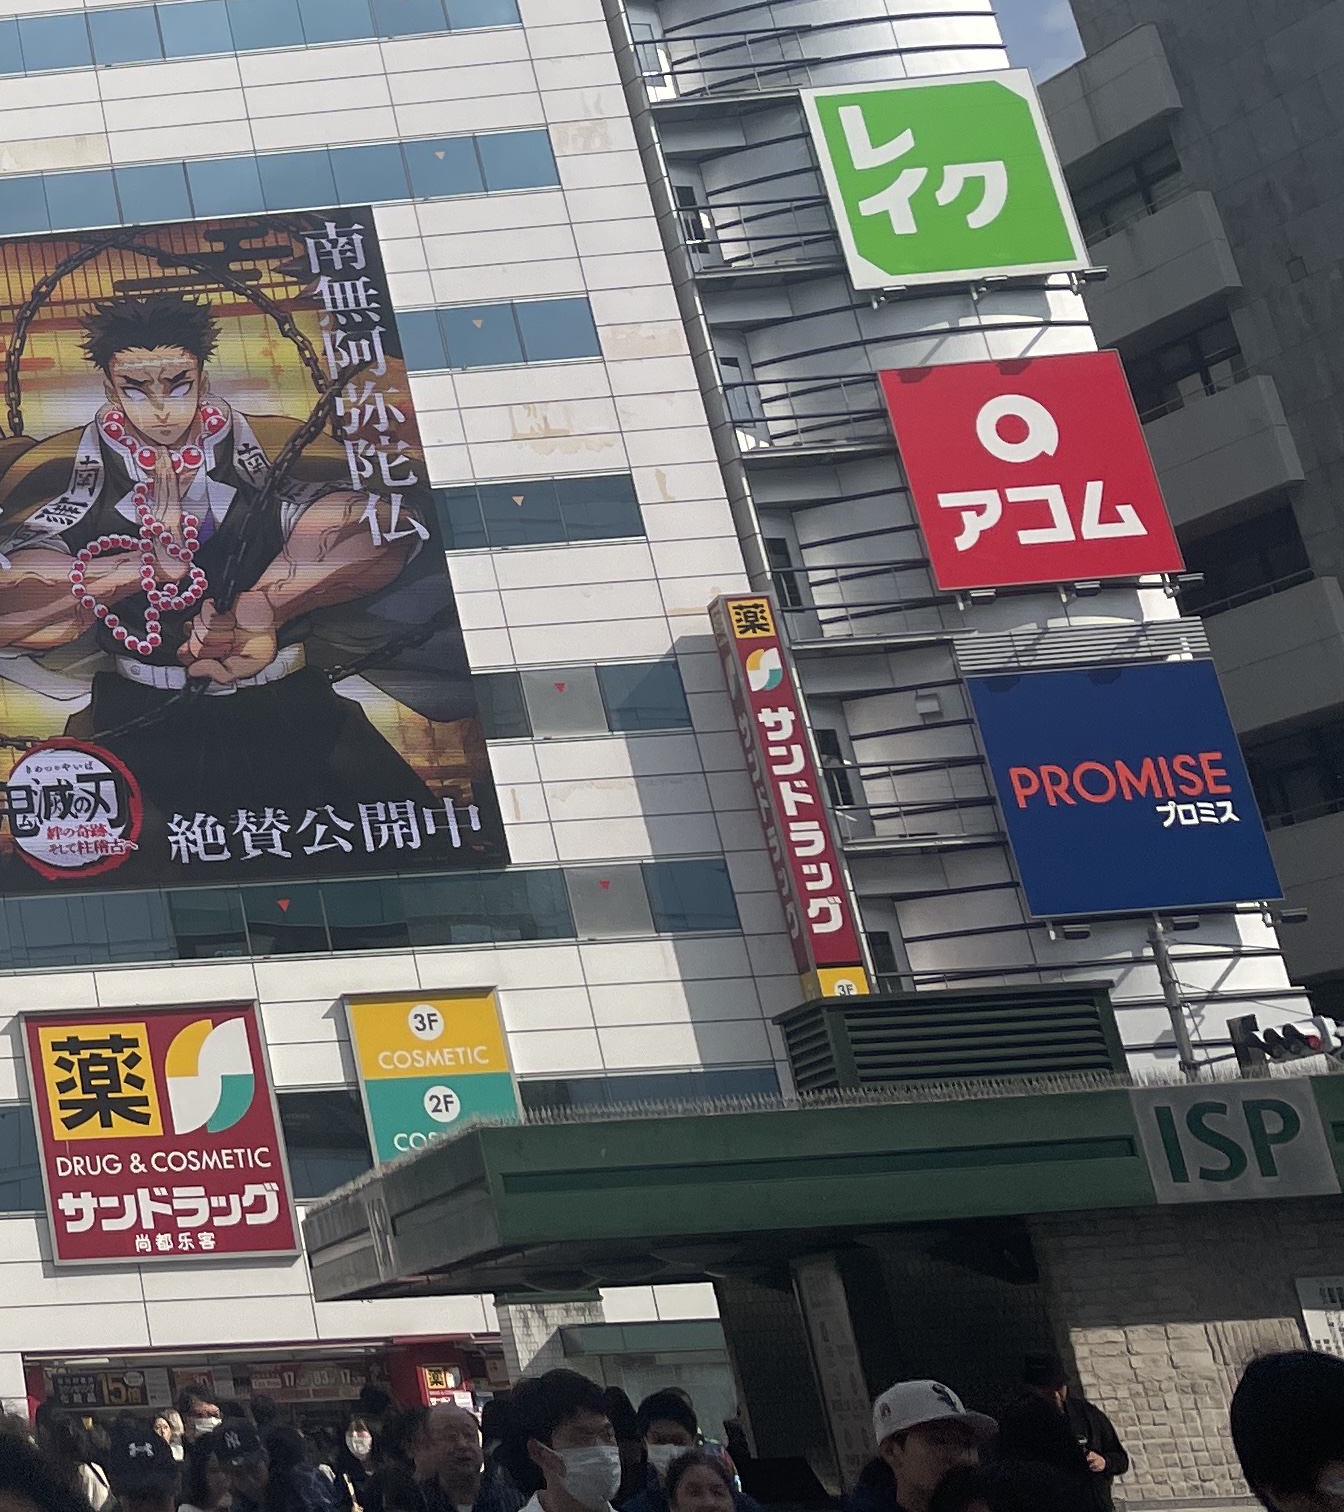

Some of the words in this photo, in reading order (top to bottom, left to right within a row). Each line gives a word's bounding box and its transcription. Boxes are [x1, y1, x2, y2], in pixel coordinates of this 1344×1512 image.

[937, 480, 1148, 552] アコム
[732, 603, 771, 635] 薬
[1009, 751, 1232, 808] PROMISE
[168, 797, 482, 865] 絶賛公開中
[758, 707, 844, 934] サンドラッグ
[1156, 800, 1240, 828] プロミス
[412, 1013, 438, 1032] 3F
[378, 1046, 490, 1069] COSMETIC
[51, 1034, 152, 1131] 薬
[428, 1094, 455, 1114] 2F
[56, 1154, 123, 1178] DRUG
[129, 1153, 147, 1174] &
[151, 1146, 272, 1172] COSMETIC
[1153, 1098, 1301, 1186] ISP
[57, 1182, 280, 1234] サンドラッグ
[135, 1231, 216, 1252] 尚都乐客
